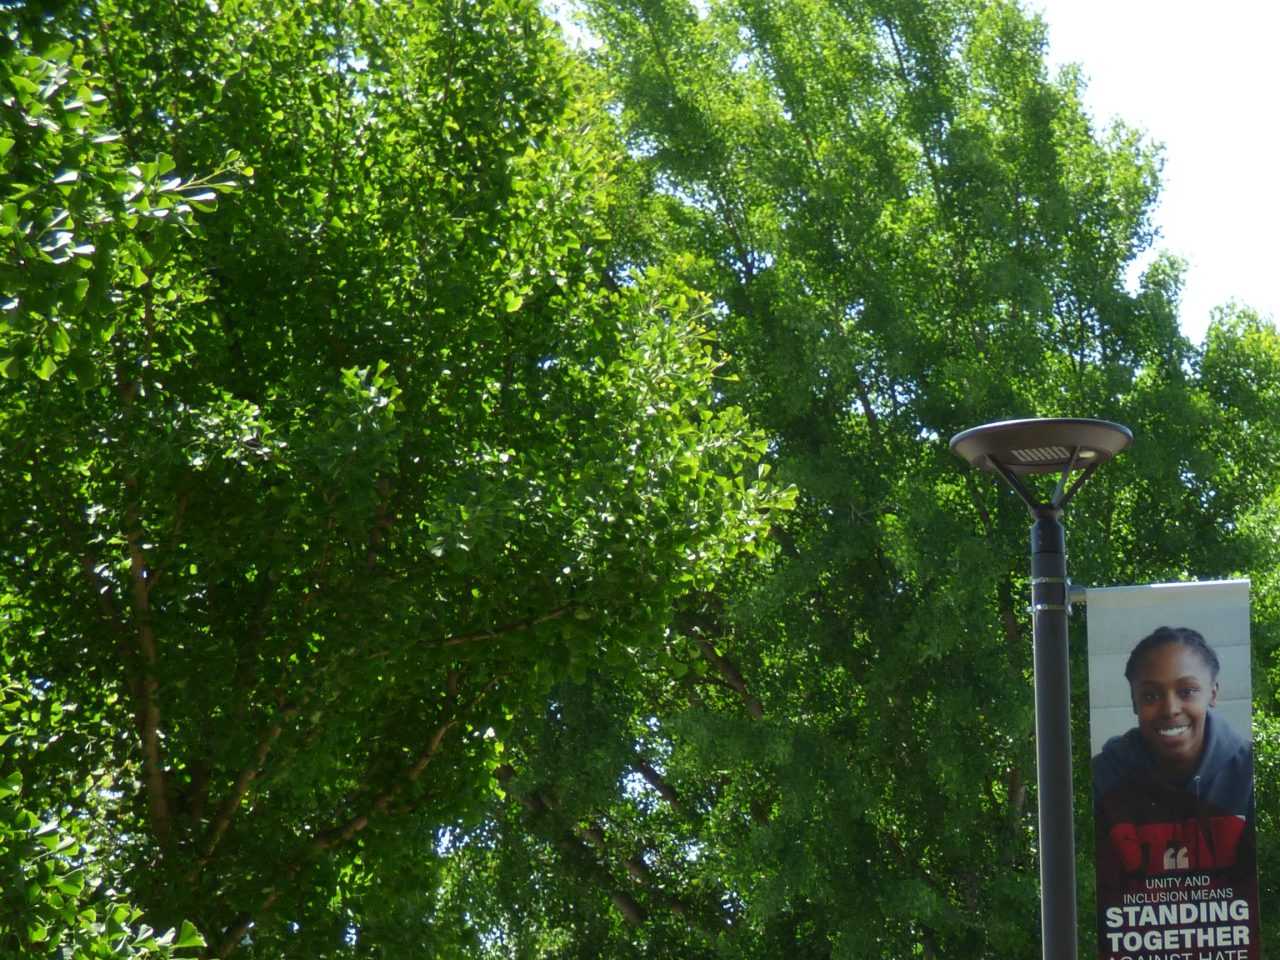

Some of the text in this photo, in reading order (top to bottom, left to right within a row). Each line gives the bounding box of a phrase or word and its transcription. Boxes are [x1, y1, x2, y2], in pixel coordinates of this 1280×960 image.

[1146, 875, 1211, 889] UNITY AND
[1123, 887, 1233, 905] INCLUSION MEANS
[1105, 899, 1250, 929] STANDING
[1106, 925, 1250, 953] TOGETHER
